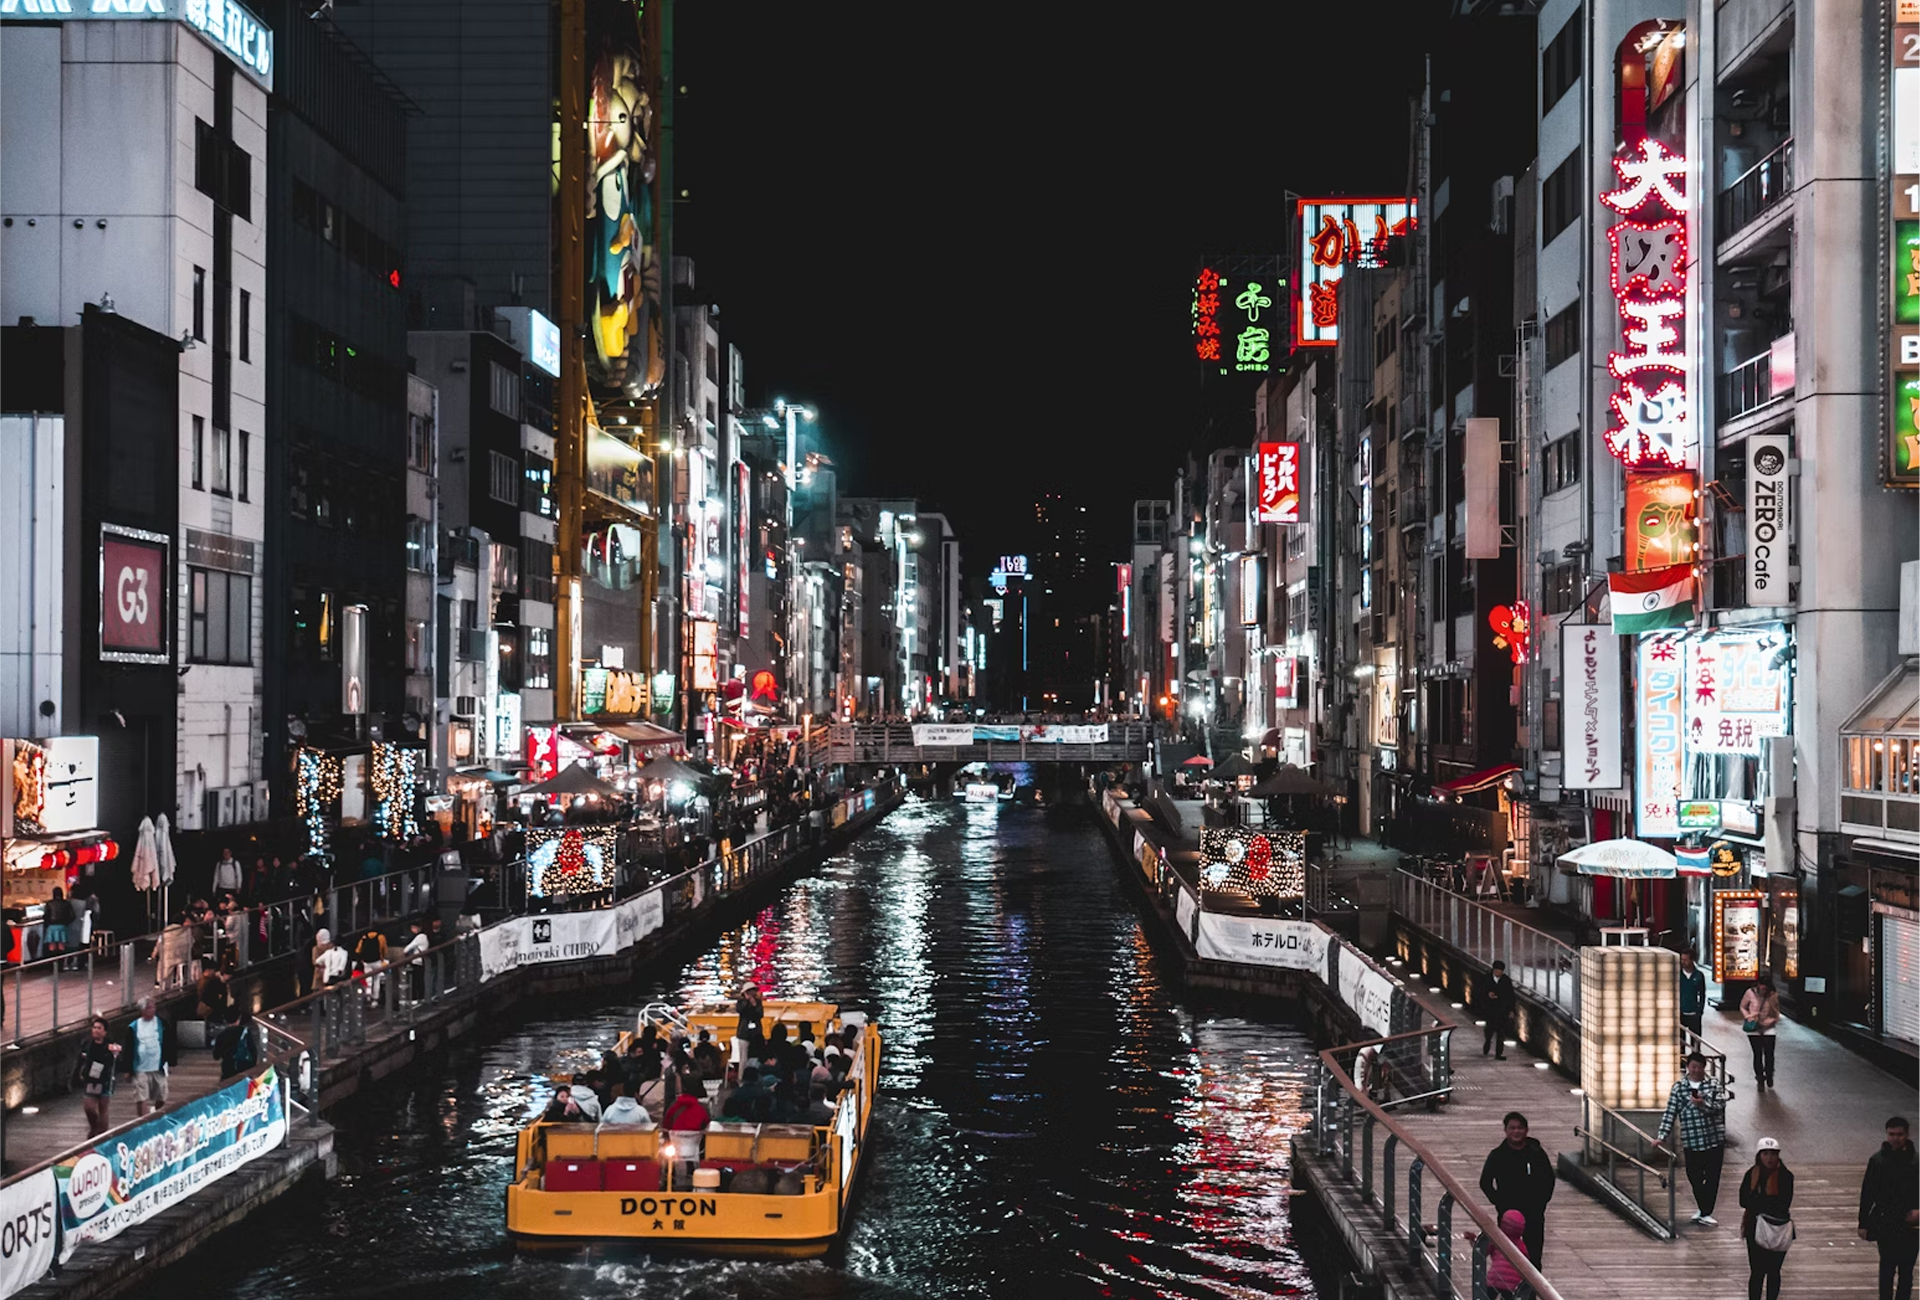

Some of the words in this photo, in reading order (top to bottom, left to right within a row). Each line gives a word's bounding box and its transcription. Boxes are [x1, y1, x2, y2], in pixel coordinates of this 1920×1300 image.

[1196, 268, 1220, 361] お好み焼
[1601, 139, 1691, 468] 大阪王将
[1263, 453, 1278, 503] ドラッグ
[1278, 446, 1296, 492] ツルハ
[1755, 481, 1777, 543] ZERO
[118, 566, 148, 625] G3
[1584, 629, 1601, 783] よしもとエンタメショップ
[1650, 670, 1677, 754] ダイコク
[1717, 718, 1753, 748] 免税
[72, 1162, 108, 1197] WAON
[77, 1191, 102, 1210] presents
[620, 1197, 716, 1217] DOTON
